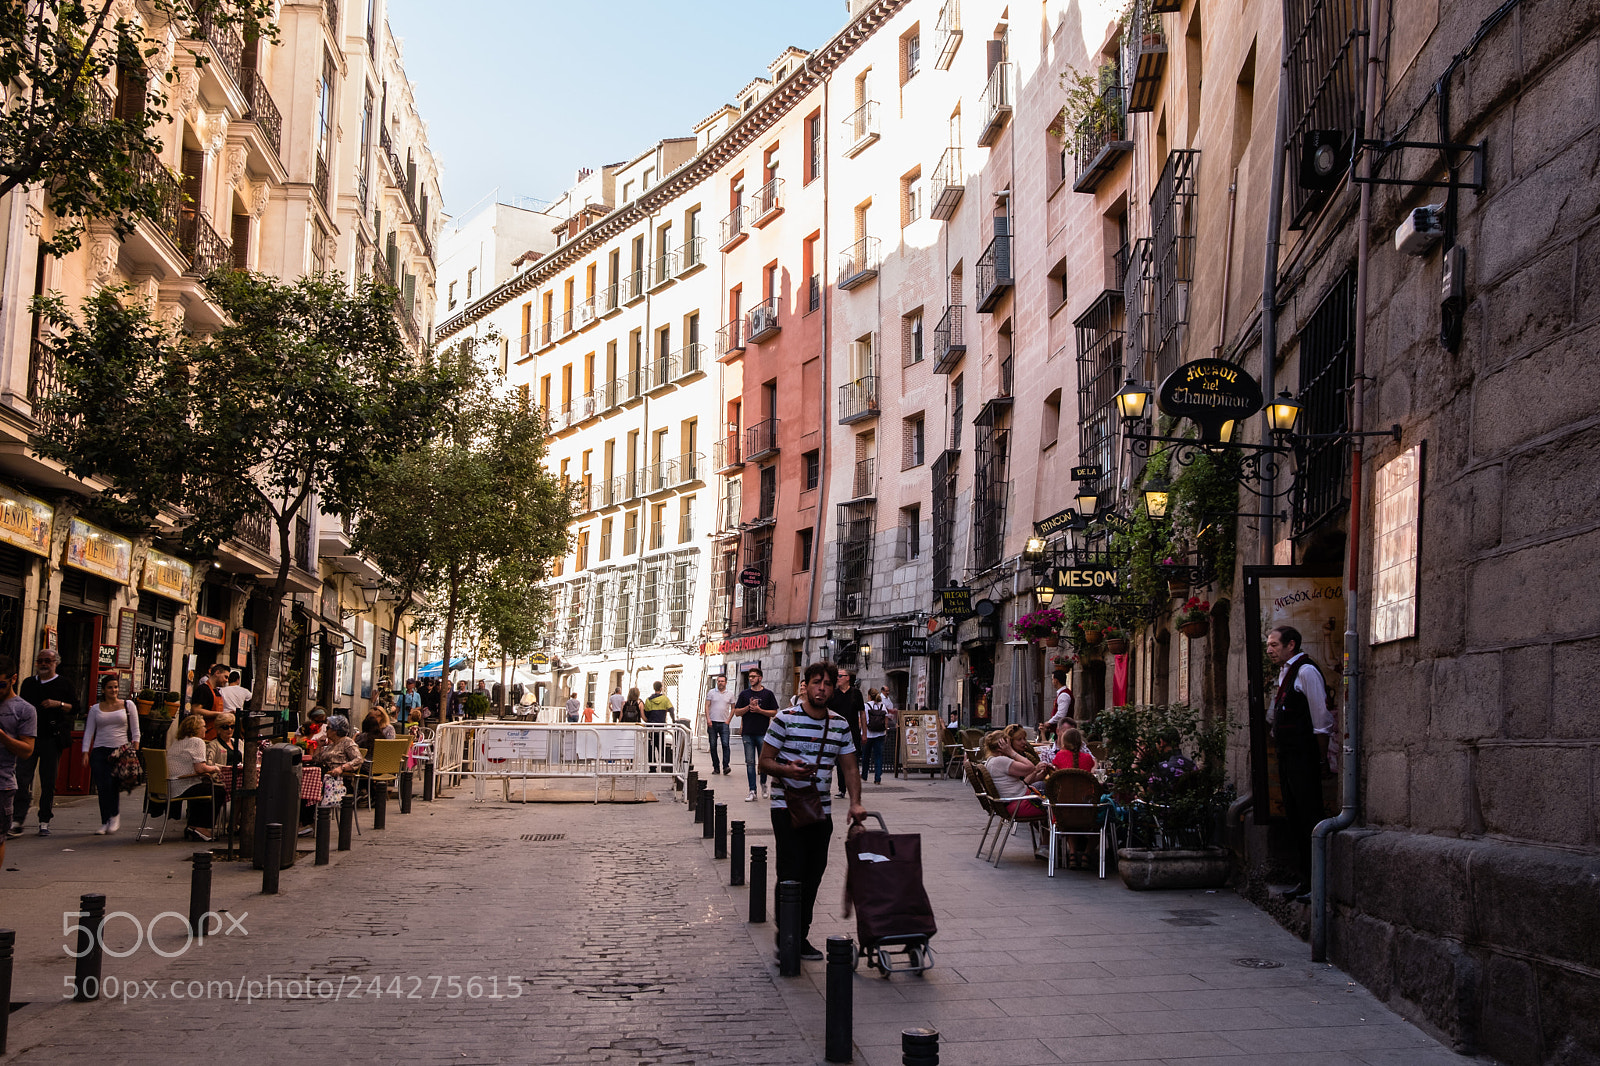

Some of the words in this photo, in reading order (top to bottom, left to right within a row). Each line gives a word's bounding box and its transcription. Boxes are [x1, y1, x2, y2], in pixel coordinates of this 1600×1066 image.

[1203, 377, 1219, 391] del
[1040, 512, 1072, 533] RINCON
[1058, 570, 1117, 587] MESON
[99, 646, 115, 656] PULPO
